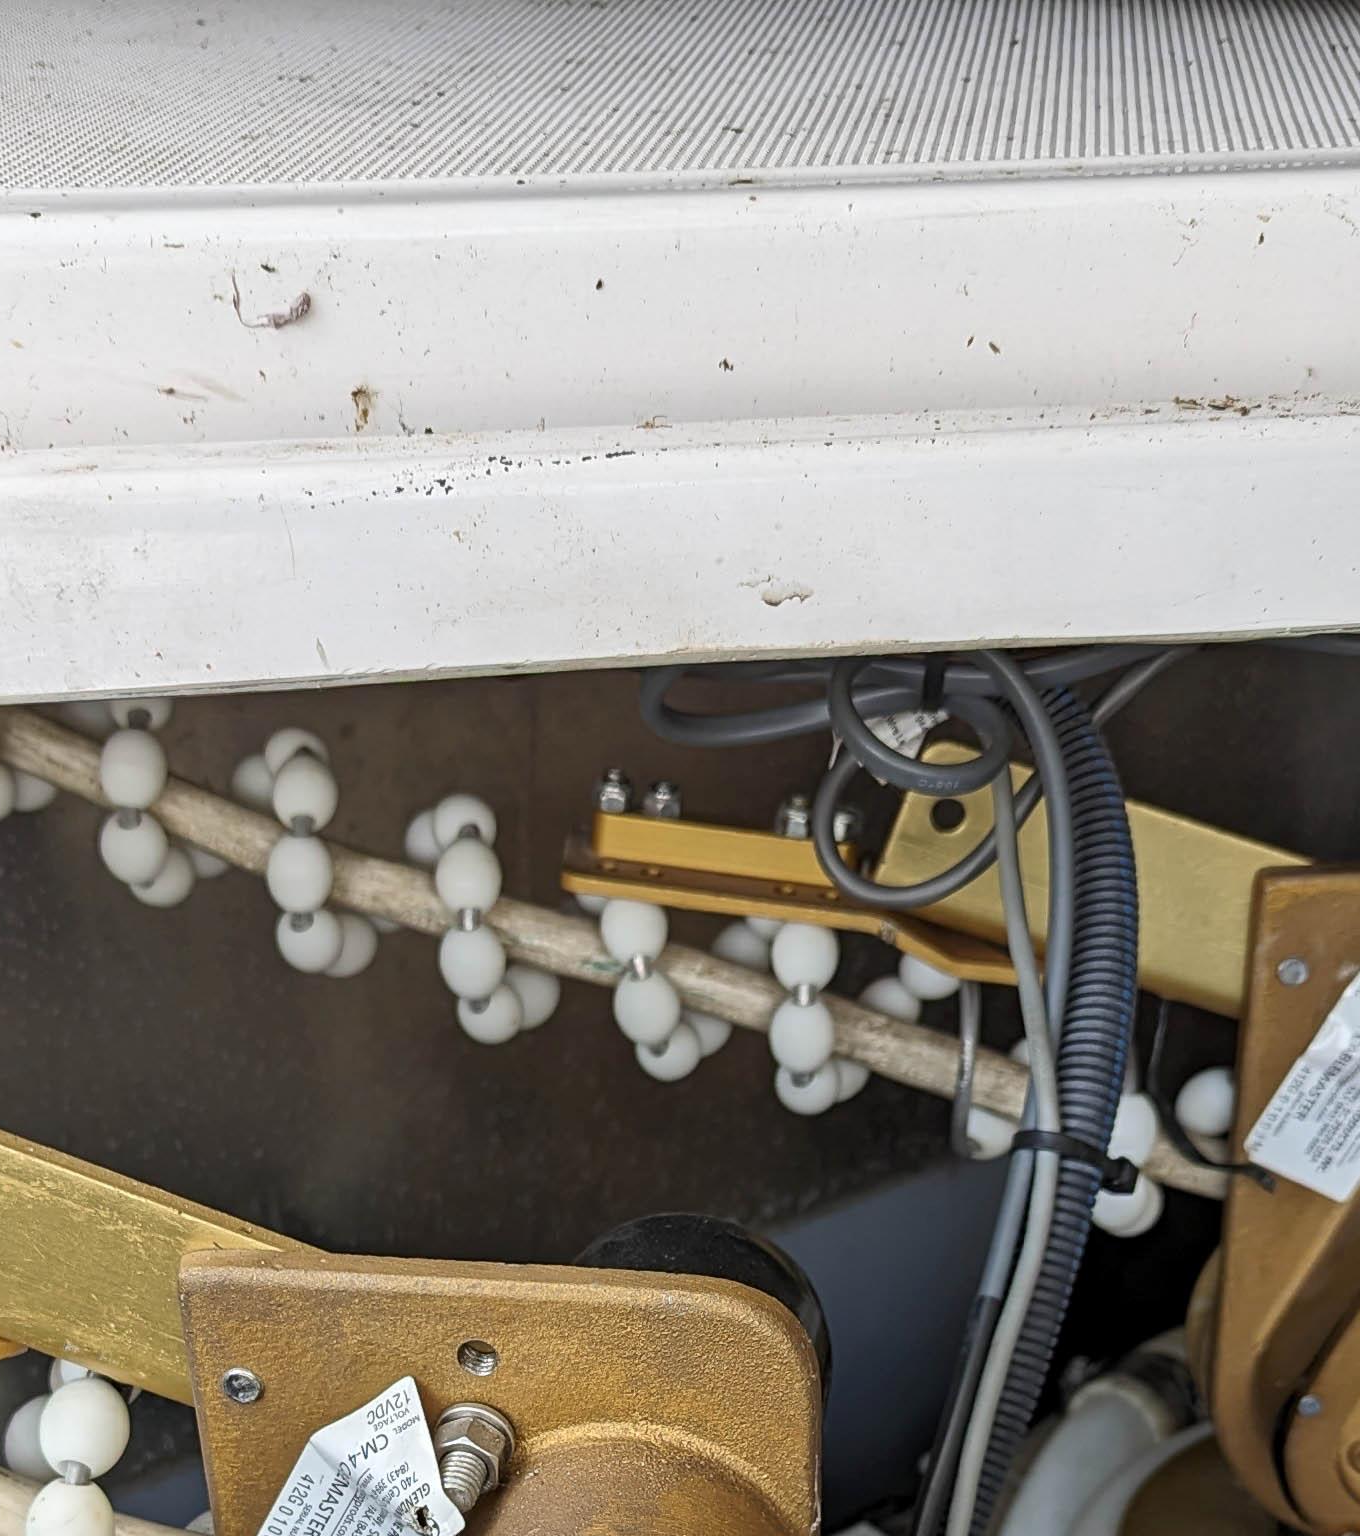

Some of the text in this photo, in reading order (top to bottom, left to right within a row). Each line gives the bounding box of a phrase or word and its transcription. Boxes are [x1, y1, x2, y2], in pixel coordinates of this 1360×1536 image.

[363, 1389, 411, 1425] 12VDC
[371, 1408, 410, 1432] VOLTAGE
[391, 1413, 421, 1435] MODEL
[348, 1431, 391, 1468] CM-4
[384, 1461, 411, 1484] (843)
[398, 1471, 419, 1490] 740
[287, 1472, 316, 1507] 412G
[294, 1502, 313, 1526] SERIAL
